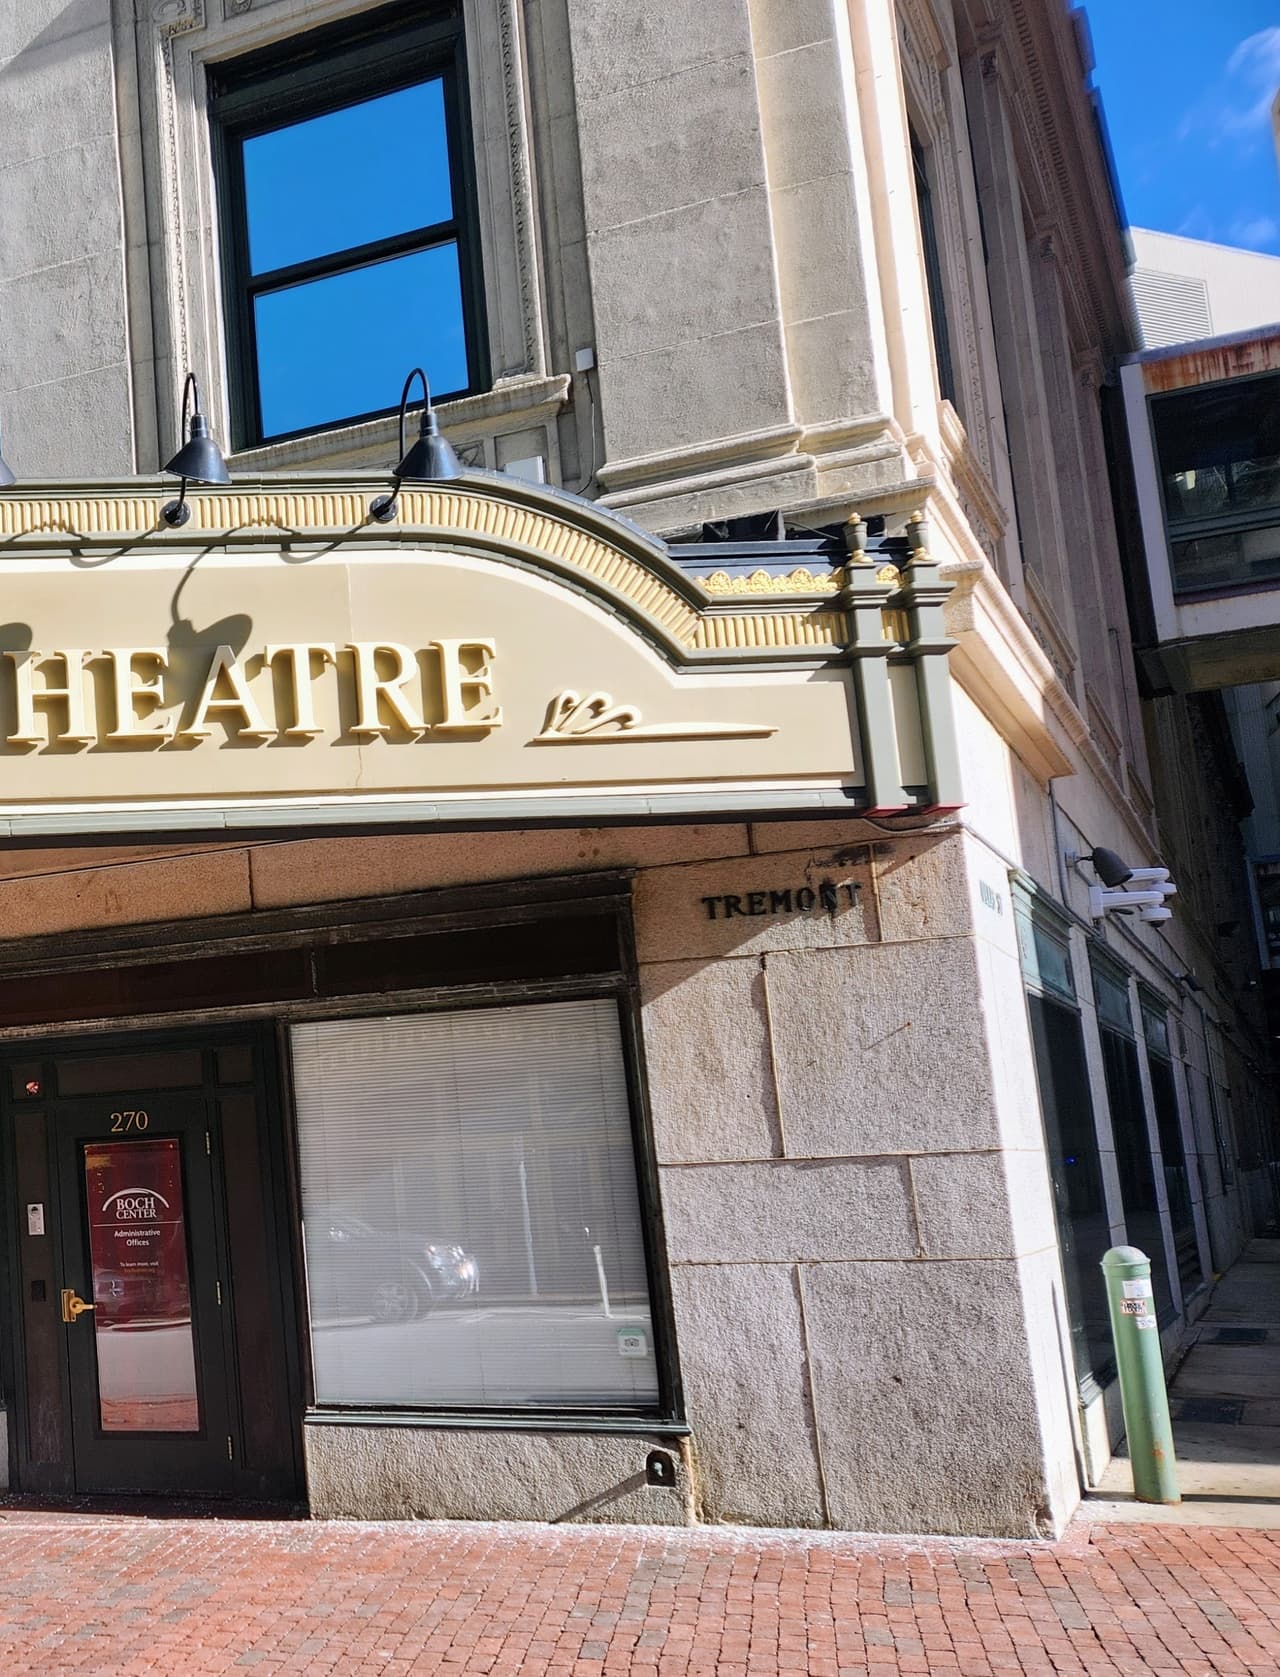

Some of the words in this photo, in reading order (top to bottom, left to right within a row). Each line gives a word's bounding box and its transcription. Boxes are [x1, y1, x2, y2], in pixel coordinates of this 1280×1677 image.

[701, 880, 863, 922] TREMONT
[110, 1110, 149, 1132] 270
[116, 1196, 156, 1211] BOCH
[115, 1208, 157, 1220] CENTER
[114, 1229, 161, 1238] Administrative
[126, 1239, 150, 1247] Offices
